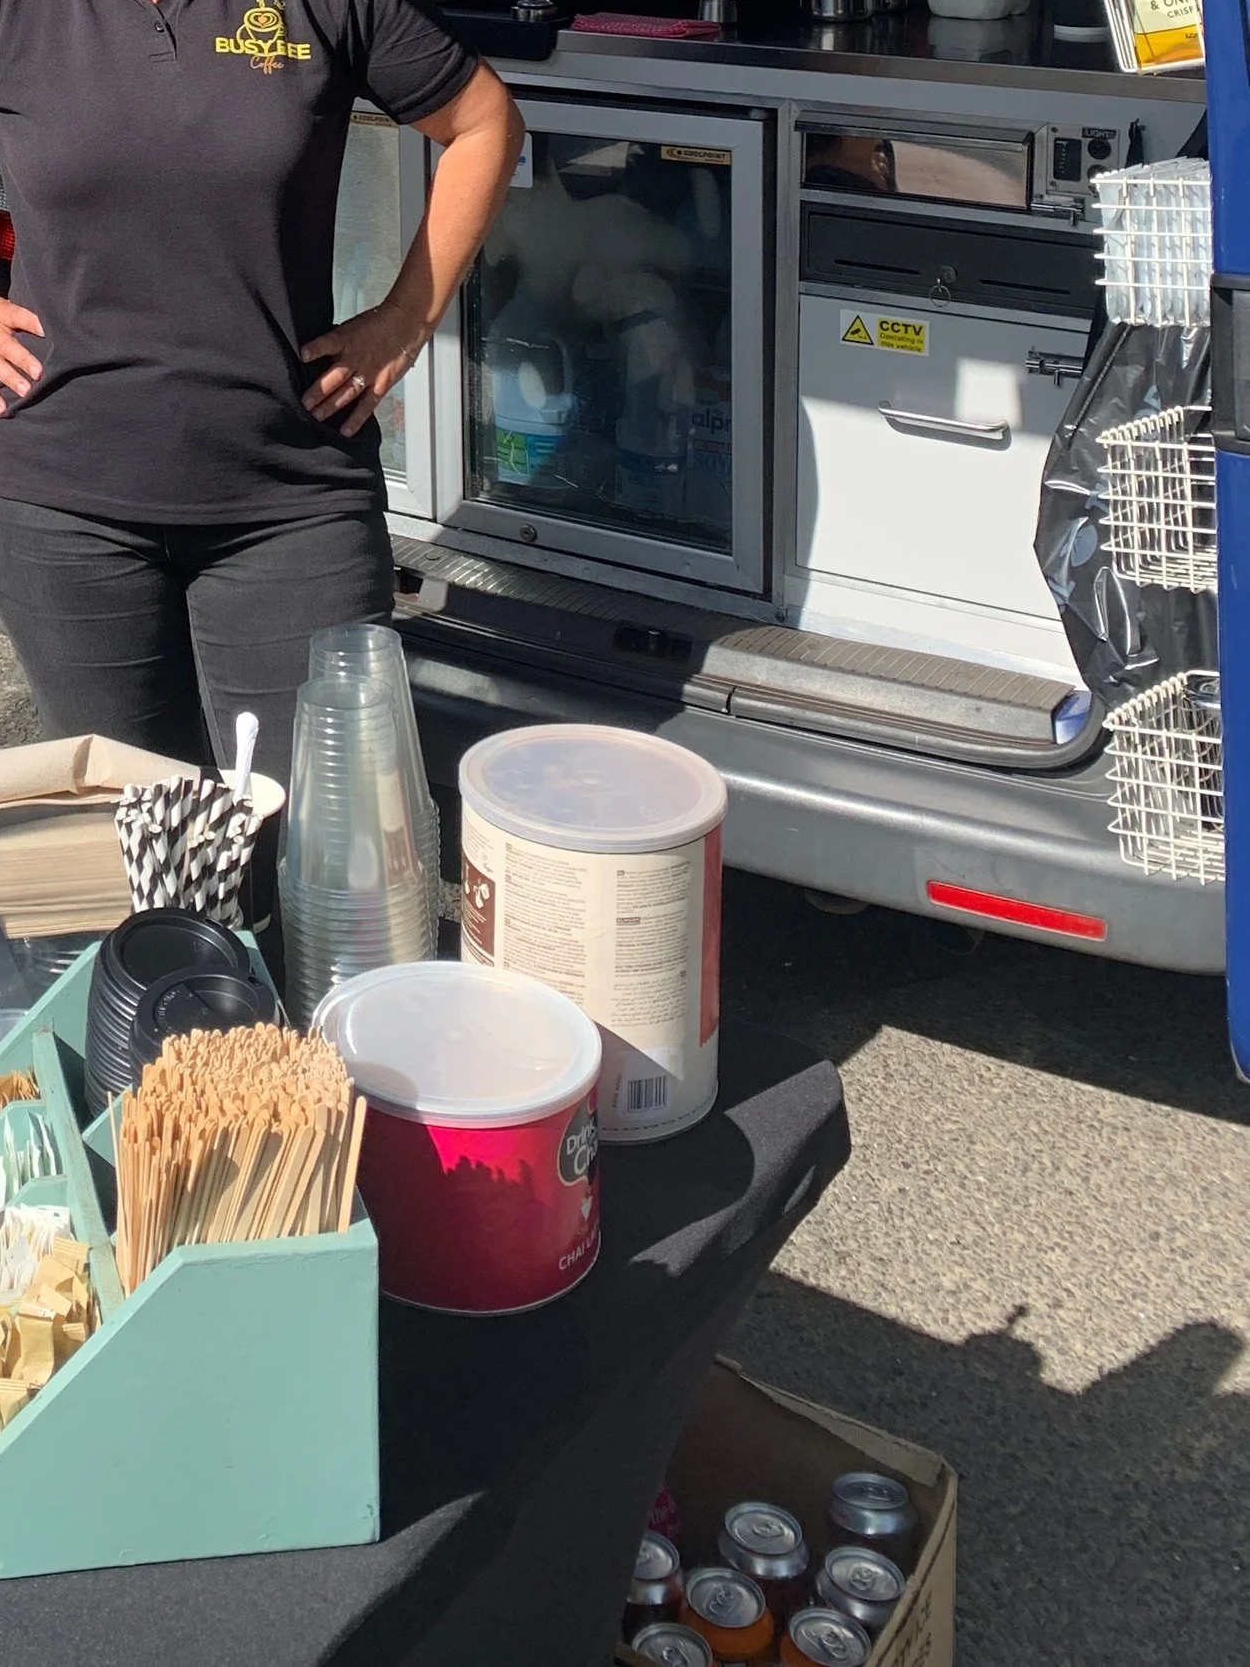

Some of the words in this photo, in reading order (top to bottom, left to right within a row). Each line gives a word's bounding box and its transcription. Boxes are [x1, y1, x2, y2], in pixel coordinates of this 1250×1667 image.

[1167, 6, 1196, 19] CRISP
[215, 37, 271, 55] BUSY
[250, 55, 285, 75] Coffee
[879, 320, 923, 336] CCTV
[880, 332, 915, 344] Operating
[691, 408, 732, 435] alpr
[558, 1242, 585, 1271] CHAI
